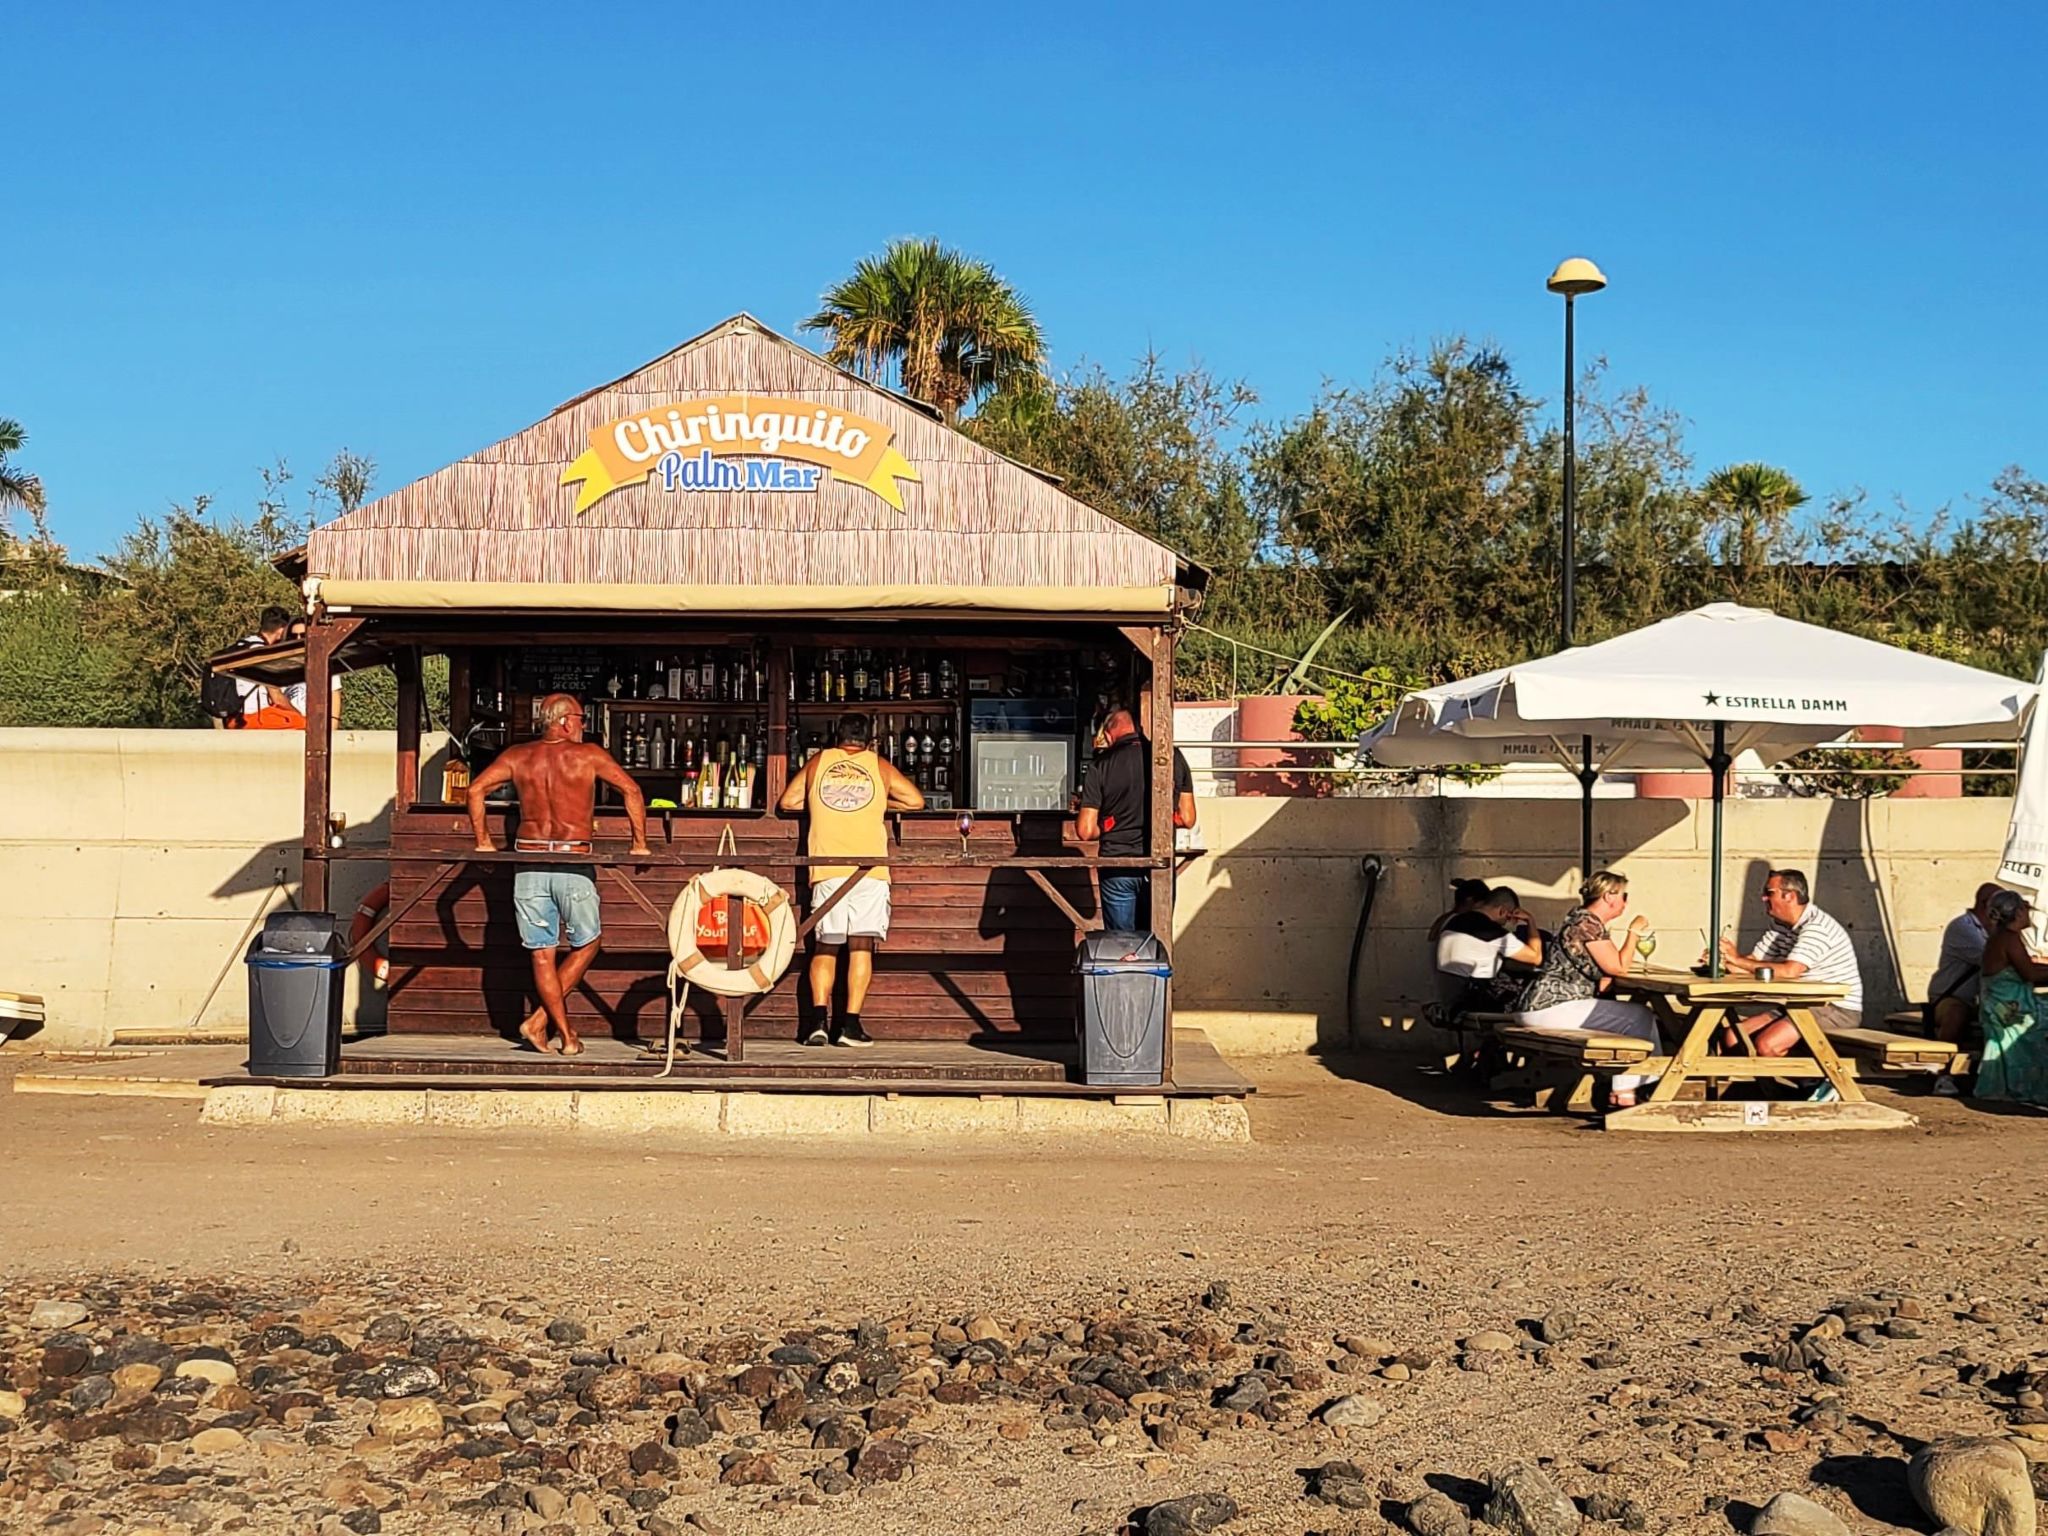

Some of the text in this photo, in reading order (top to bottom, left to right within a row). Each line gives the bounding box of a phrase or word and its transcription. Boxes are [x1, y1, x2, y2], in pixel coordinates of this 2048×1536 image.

[614, 405, 871, 462] Chiringuito
[659, 449, 820, 489] Palm Mar
[1725, 696, 1848, 711] ESTRELLA DAMM
[713, 910, 728, 925] B
